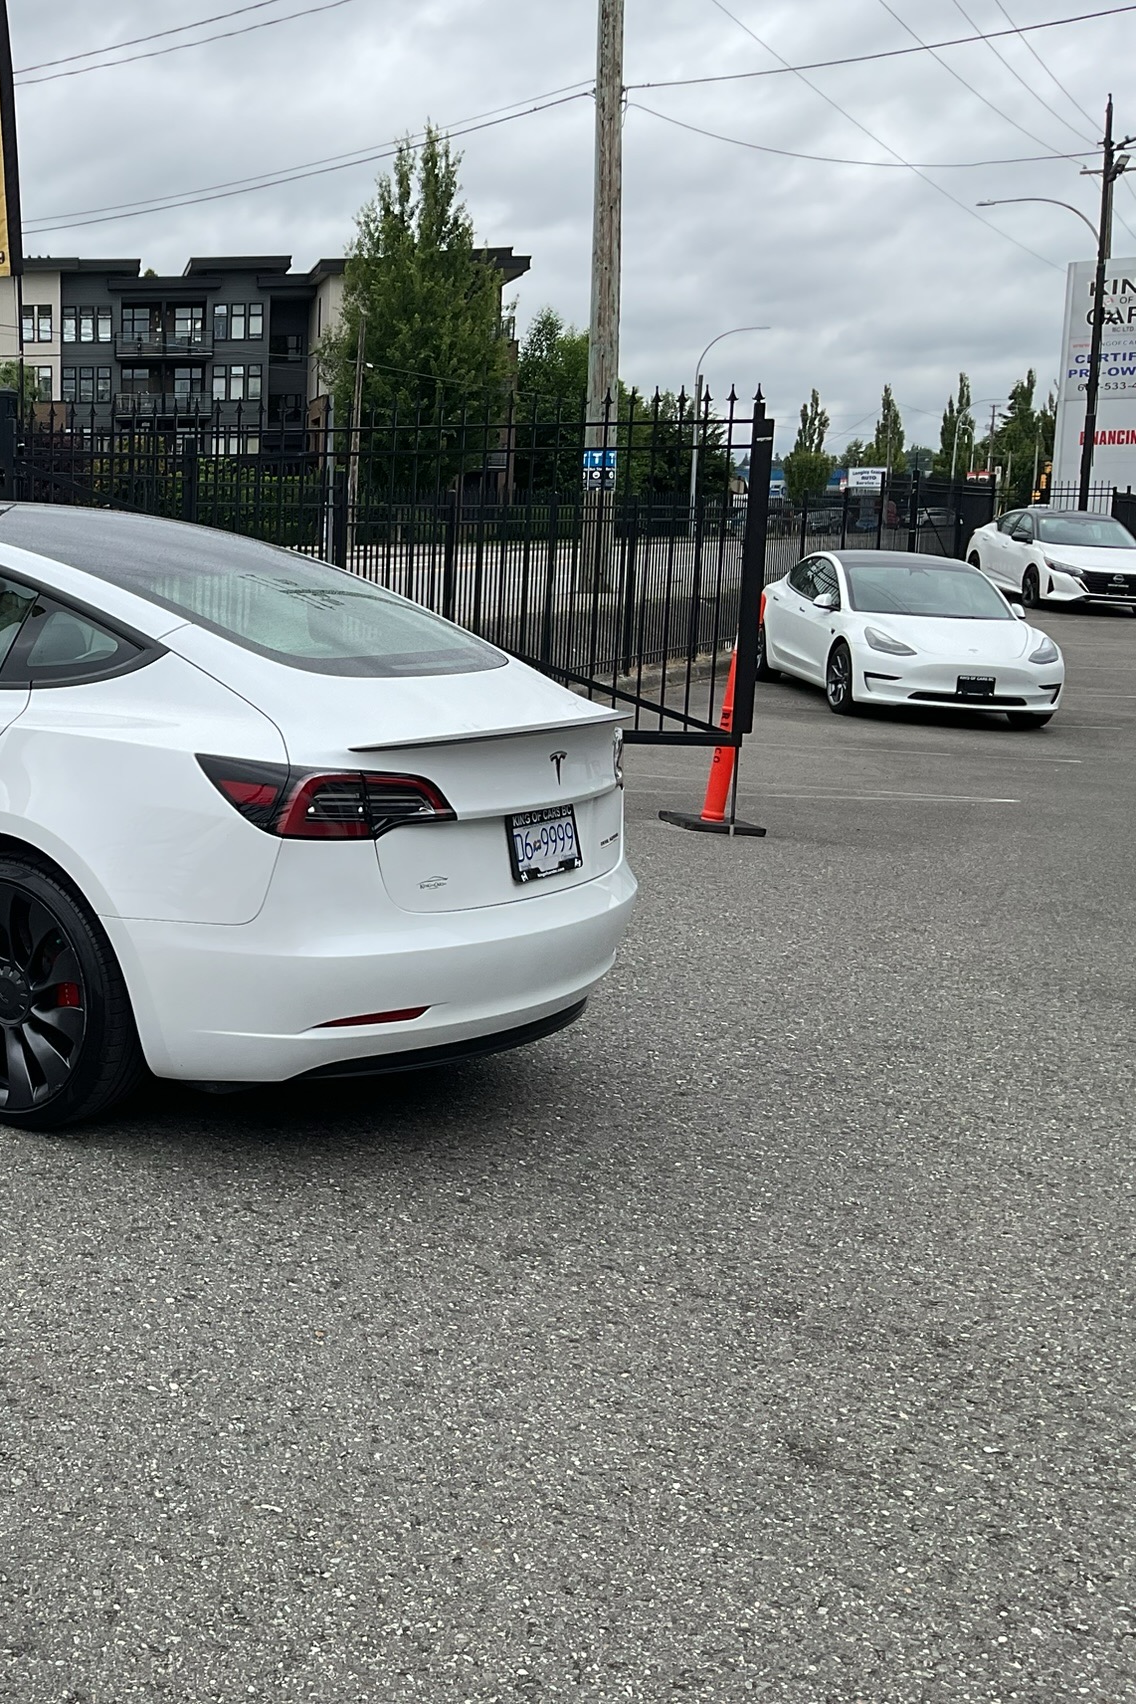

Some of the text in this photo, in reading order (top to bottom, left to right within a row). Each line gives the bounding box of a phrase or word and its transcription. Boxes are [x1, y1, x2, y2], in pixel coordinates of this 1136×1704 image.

[1119, 296, 1134, 305] OF
[512, 813, 531, 827] KING
[531, 811, 542, 823] OF
[543, 806, 561, 820] CARS
[561, 804, 572, 816] BC
